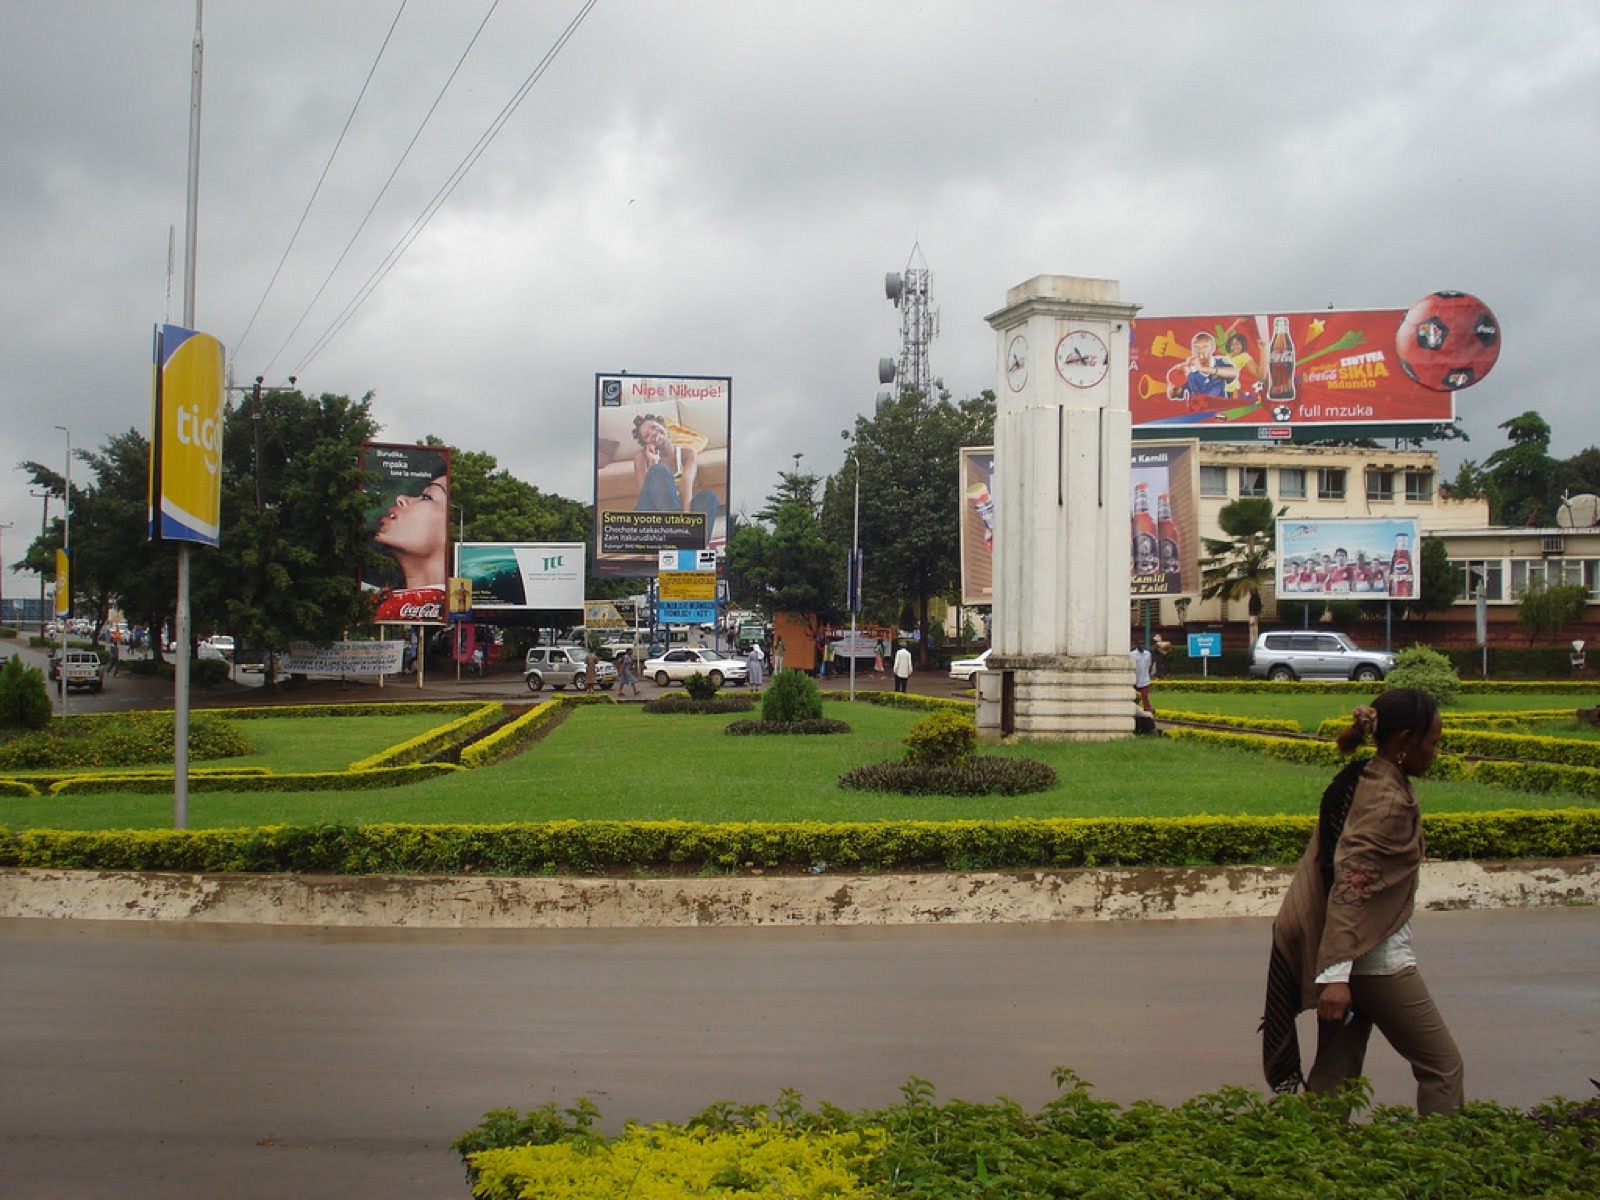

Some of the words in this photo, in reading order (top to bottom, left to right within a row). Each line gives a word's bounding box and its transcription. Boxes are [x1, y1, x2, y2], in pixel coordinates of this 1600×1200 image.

[1338, 363, 1389, 380] SIKIA
[632, 383, 665, 398] Nipe
[669, 384, 722, 400] Nikupe!
[1299, 404, 1321, 417] full
[1325, 404, 1373, 417] mzuka
[1138, 453, 1168, 463] Kamili
[604, 513, 632, 523] Sema
[633, 515, 662, 525] yoote
[665, 515, 703, 527] utakayo
[604, 525, 638, 534] Chochote
[604, 534, 619, 542] Zain
[1139, 583, 1168, 593] Zaidi
[400, 602, 441, 618] Coca-Cola
